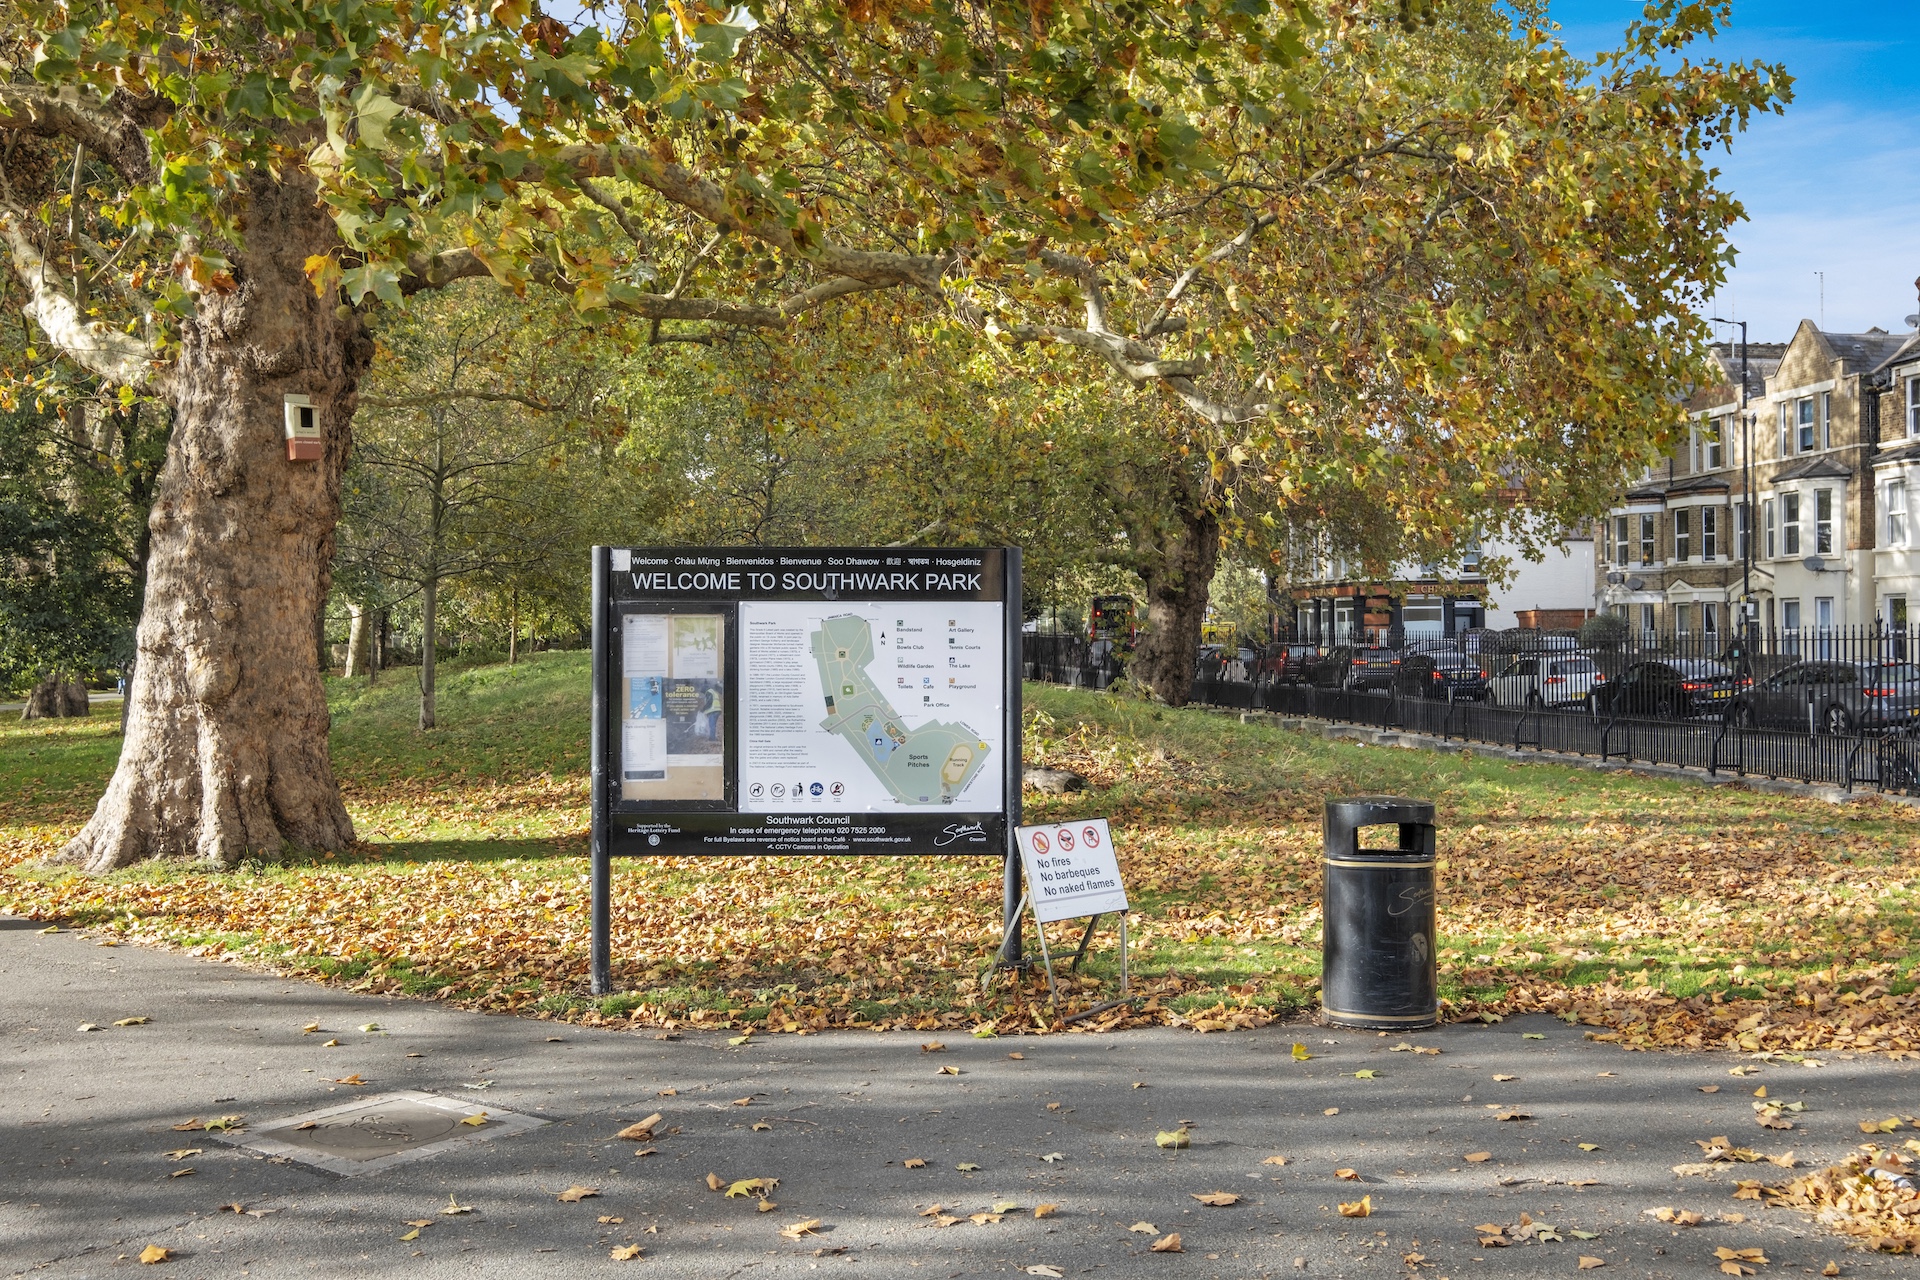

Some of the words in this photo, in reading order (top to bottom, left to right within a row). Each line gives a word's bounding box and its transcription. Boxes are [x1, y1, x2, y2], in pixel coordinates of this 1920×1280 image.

[632, 557, 668, 565] Welcome
[726, 557, 774, 565] Bienvenidos
[780, 557, 822, 565] Bienvenue
[936, 558, 981, 567] Hosgeldiniz
[632, 573, 741, 590] WELCOME
[747, 573, 776, 590] TO
[782, 573, 919, 590] SOUTHWARK
[926, 573, 981, 590] PARK
[766, 816, 814, 824] Southwark
[816, 816, 850, 824] Council
[1037, 859, 1050, 869] No
[1051, 856, 1072, 867] fires
[1040, 872, 1053, 882] No
[1055, 866, 1100, 880] barbeques
[1044, 886, 1057, 896] No
[1059, 882, 1085, 894] naked
[1086, 878, 1115, 891] flames
